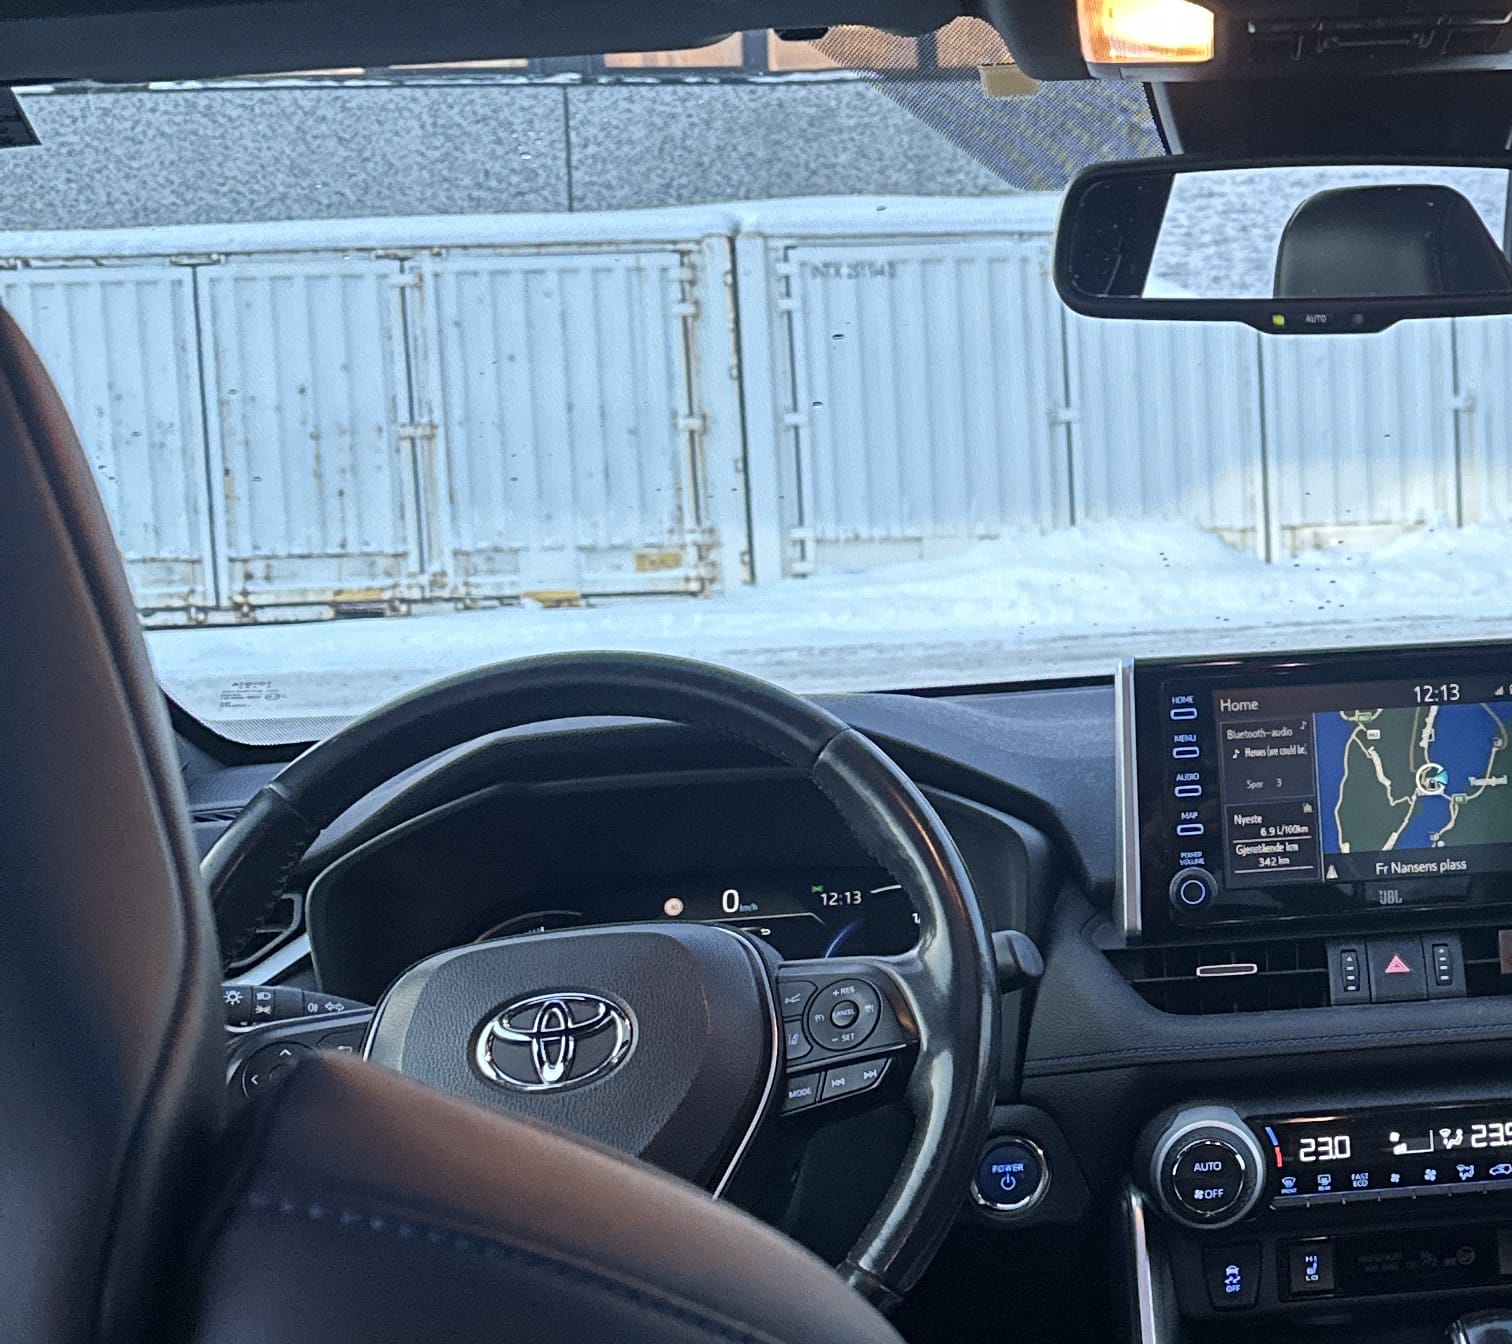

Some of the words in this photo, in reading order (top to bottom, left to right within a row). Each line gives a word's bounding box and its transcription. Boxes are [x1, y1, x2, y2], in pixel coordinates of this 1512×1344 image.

[1305, 314, 1327, 324] AUTO
[1414, 684, 1460, 703] 12:13
[1172, 696, 1194, 704] HOME
[1220, 699, 1259, 712] Home
[1174, 734, 1197, 742] MENU
[1227, 727, 1293, 740] Bluetooth-audio
[1176, 773, 1200, 781] AUDIO
[1181, 812, 1198, 820] MAP
[1234, 815, 1262, 826] Nyeste
[1260, 827, 1275, 836] 6.9
[1258, 857, 1277, 867] 342
[1278, 856, 1290, 865] km
[1376, 863, 1388, 874] Fr
[1391, 861, 1437, 873] Nansens
[1440, 858, 1467, 873] plass
[722, 889, 740, 913] 0
[820, 891, 862, 906] 12:13
[1379, 890, 1402, 904] JBL
[789, 1088, 811, 1098] MODE
[1300, 1136, 1351, 1162] 23.0
[992, 1163, 1024, 1173] POWER
[1194, 1162, 1222, 1172] AUTO
[1353, 1179, 1369, 1187] ECO
[1205, 1189, 1224, 1199] OFF
[1226, 1284, 1241, 1293] OFF
